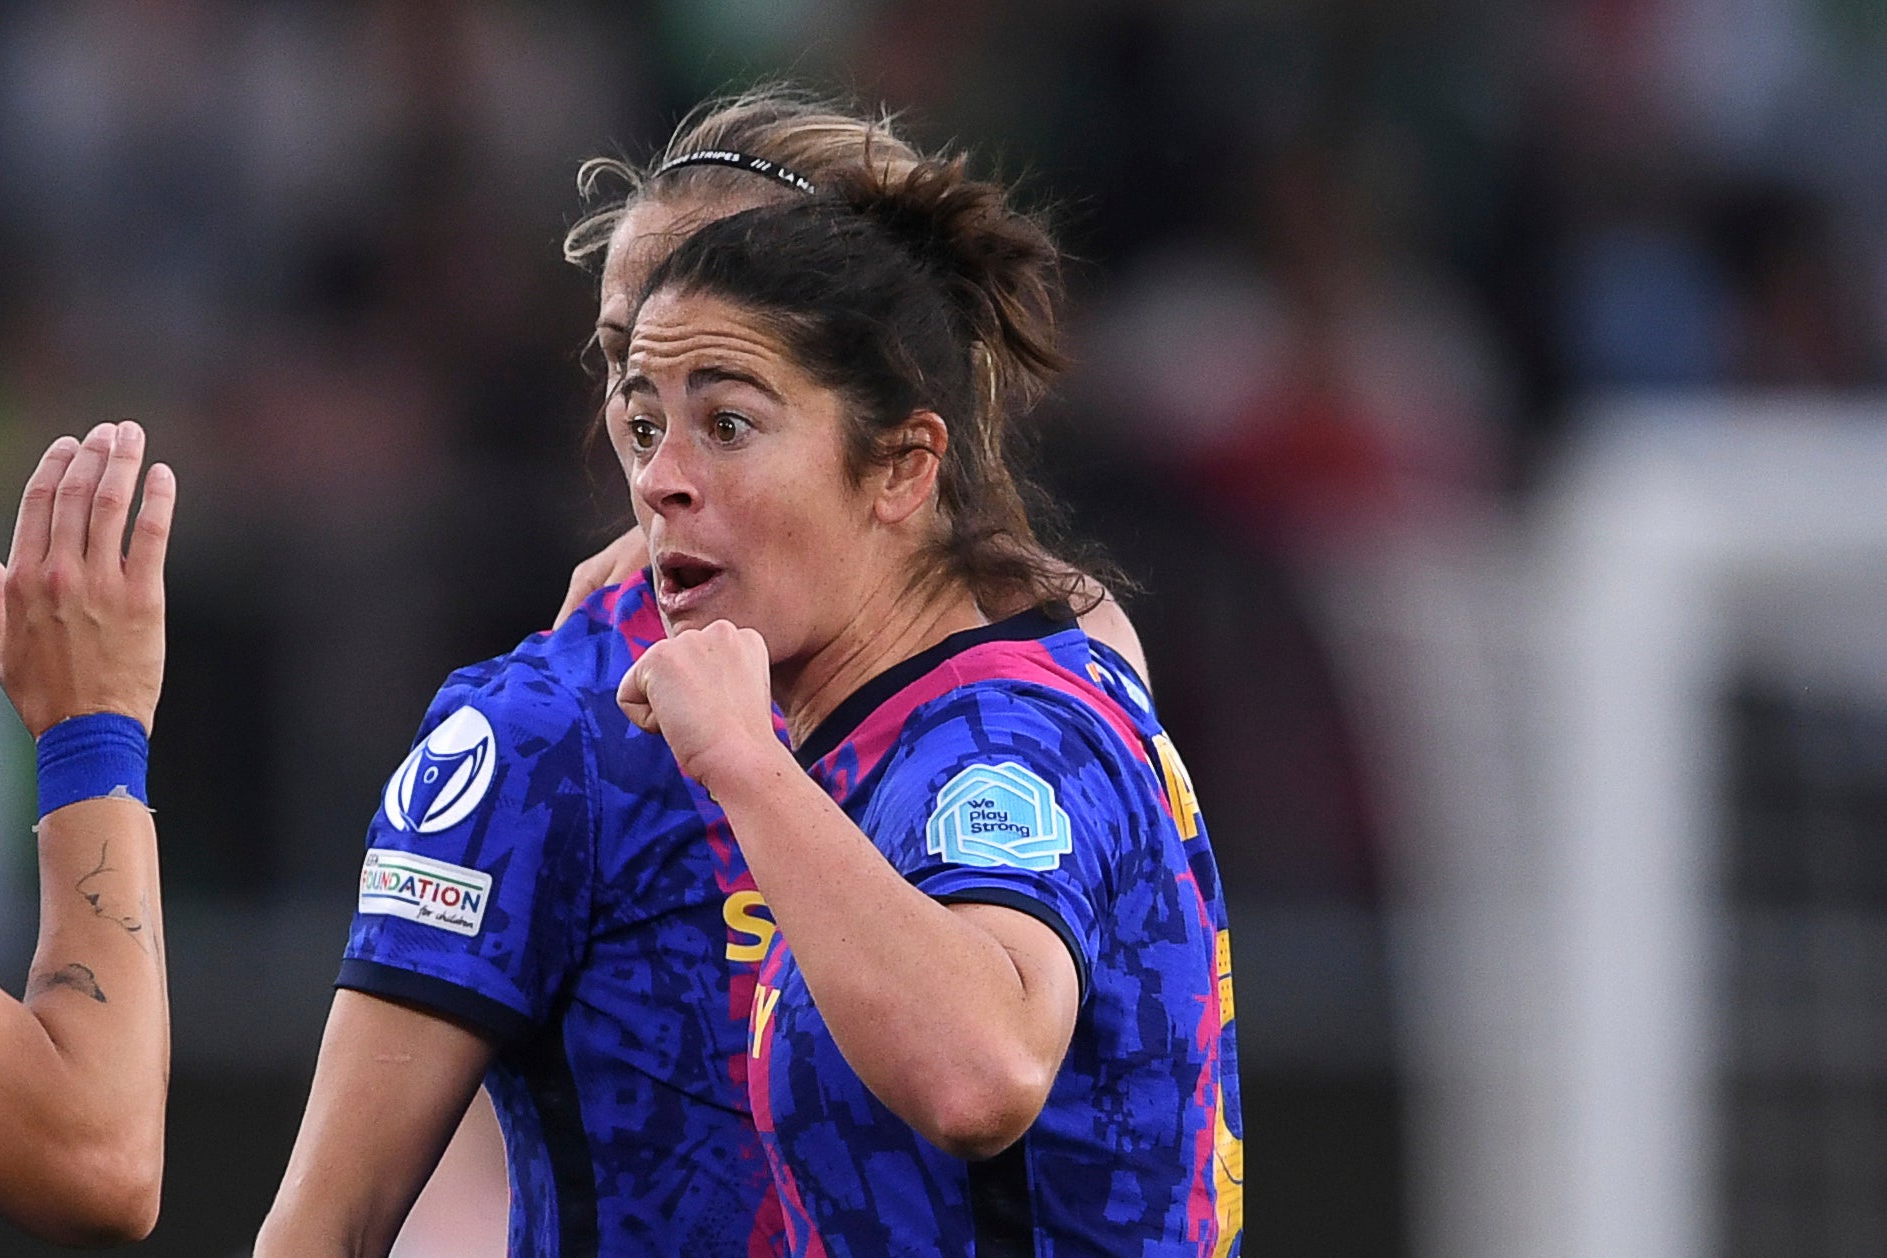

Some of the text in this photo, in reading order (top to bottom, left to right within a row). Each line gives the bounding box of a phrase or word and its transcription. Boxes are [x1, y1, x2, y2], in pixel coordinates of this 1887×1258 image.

[967, 798, 995, 809] We
[971, 822, 1030, 838] Strong
[362, 869, 481, 914] FOUNDATION
